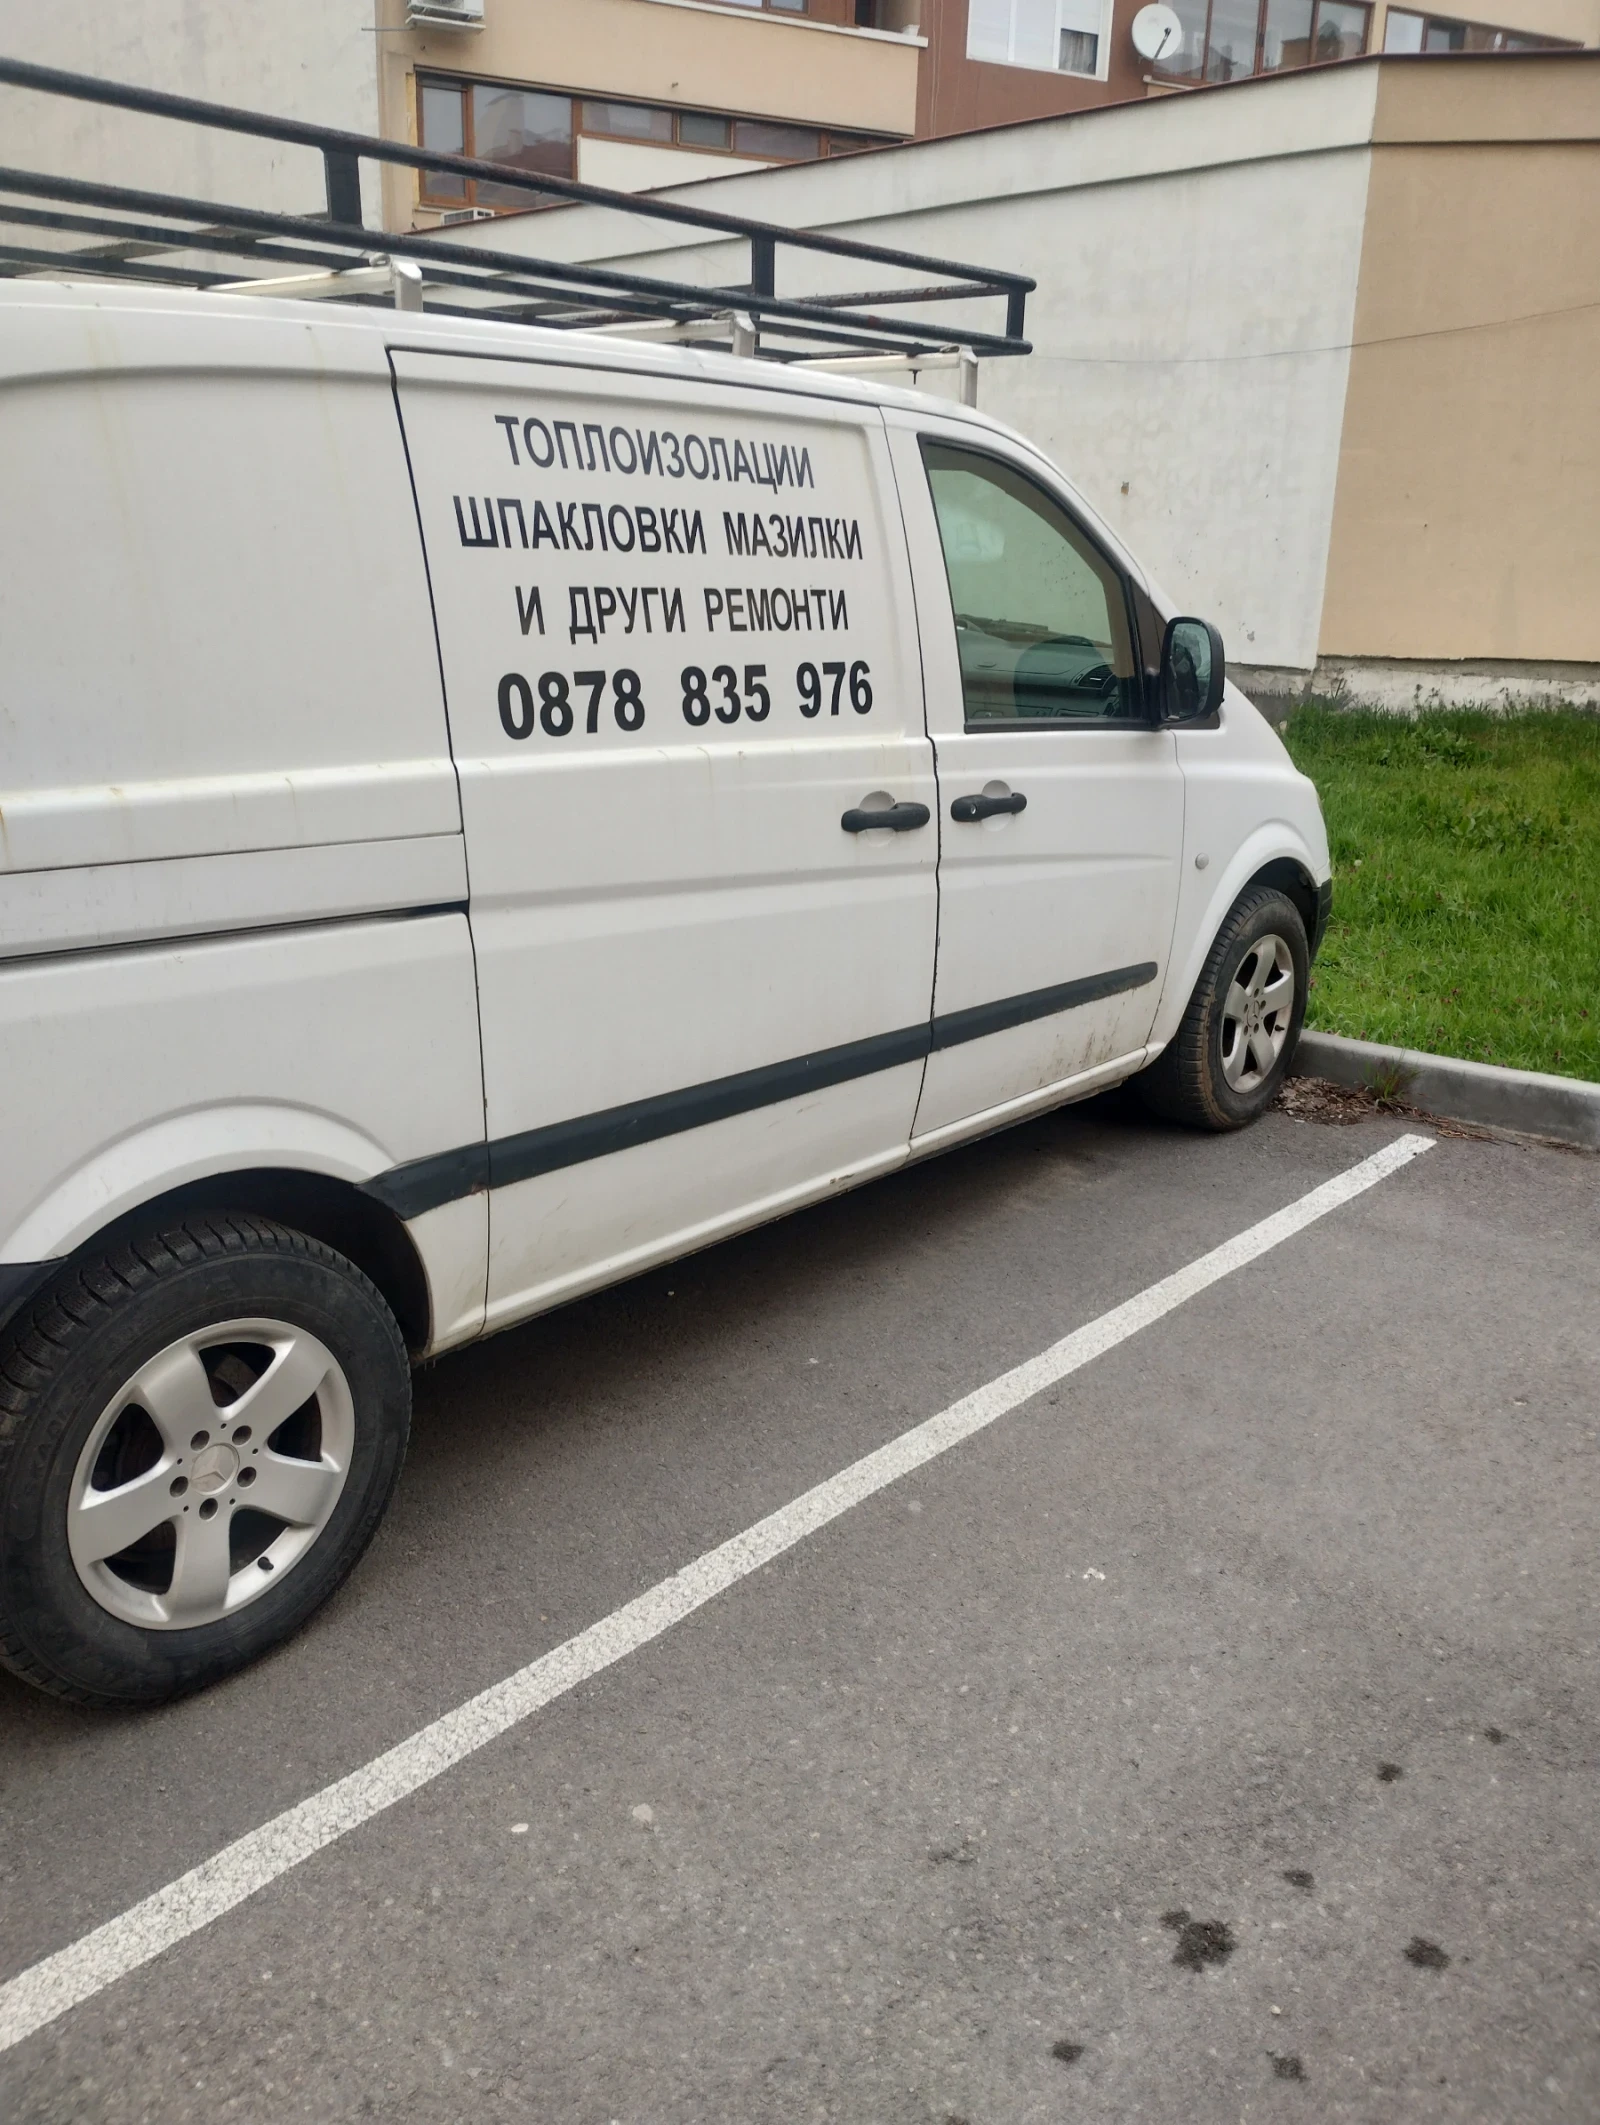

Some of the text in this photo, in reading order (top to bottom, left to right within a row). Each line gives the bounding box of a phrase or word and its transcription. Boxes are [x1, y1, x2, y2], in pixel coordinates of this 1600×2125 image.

[495, 415, 815, 495] ТОПЛОИЗОЛАЦИИ
[453, 496, 863, 560] ШПАКЛОВКИ МАЗИЛКИ
[515, 586, 849, 645] И ДРУГИ РЕМОНТИ
[498, 660, 874, 740] 0878 835 976
